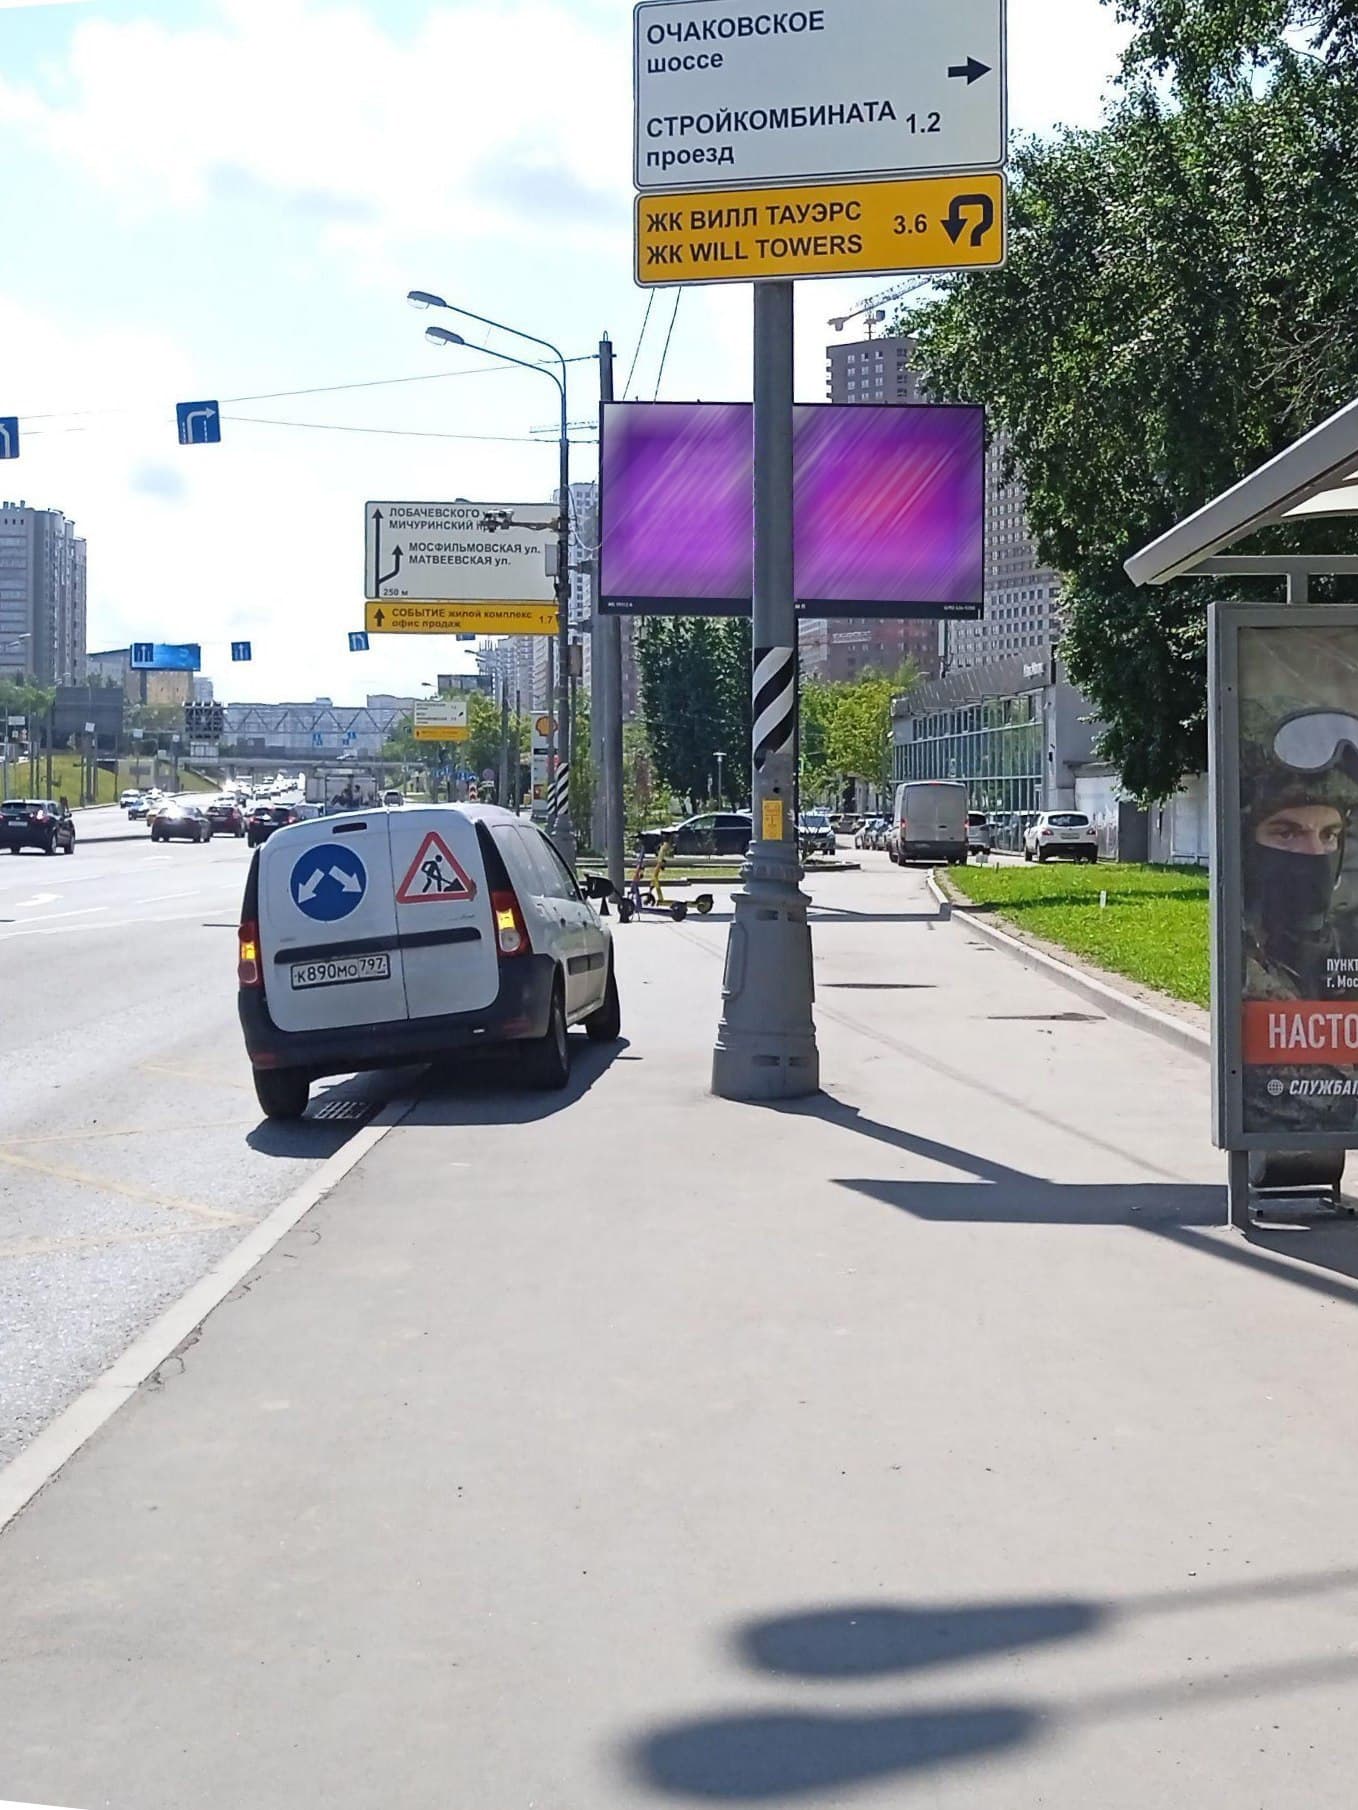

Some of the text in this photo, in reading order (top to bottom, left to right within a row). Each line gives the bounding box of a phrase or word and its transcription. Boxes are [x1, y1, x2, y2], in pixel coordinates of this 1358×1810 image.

[647, 10, 825, 45] ОЧАКОВСКОЕ
[647, 52, 724, 74] шоссе
[646, 101, 941, 138] СТРОЙКОМБИНАТА 1.2
[647, 145, 735, 170] проезд
[646, 200, 927, 235] ЖК ВИЛЛ ТАУЭРС 3.6
[646, 234, 863, 265] ЖК WILL TOWERS
[389, 508, 480, 519] ЛОБАЧЕВСКОГО
[389, 519, 473, 530] МИЧУРИНСКИЙ
[409, 542, 541, 556] МОСФИЛЬМОВСКАЯ ул.
[409, 555, 511, 567] МАТВЕЕВСКАЯ ул.
[383, 588, 399, 596] 250
[392, 608, 446, 618] СОБЫТИЕ
[448, 609, 481, 618] жилой
[484, 611, 532, 619] комплекс
[392, 620, 461, 629] офис продаж
[297, 958, 383, 983] К890МО 797
[1326, 978, 1335, 988] г.
